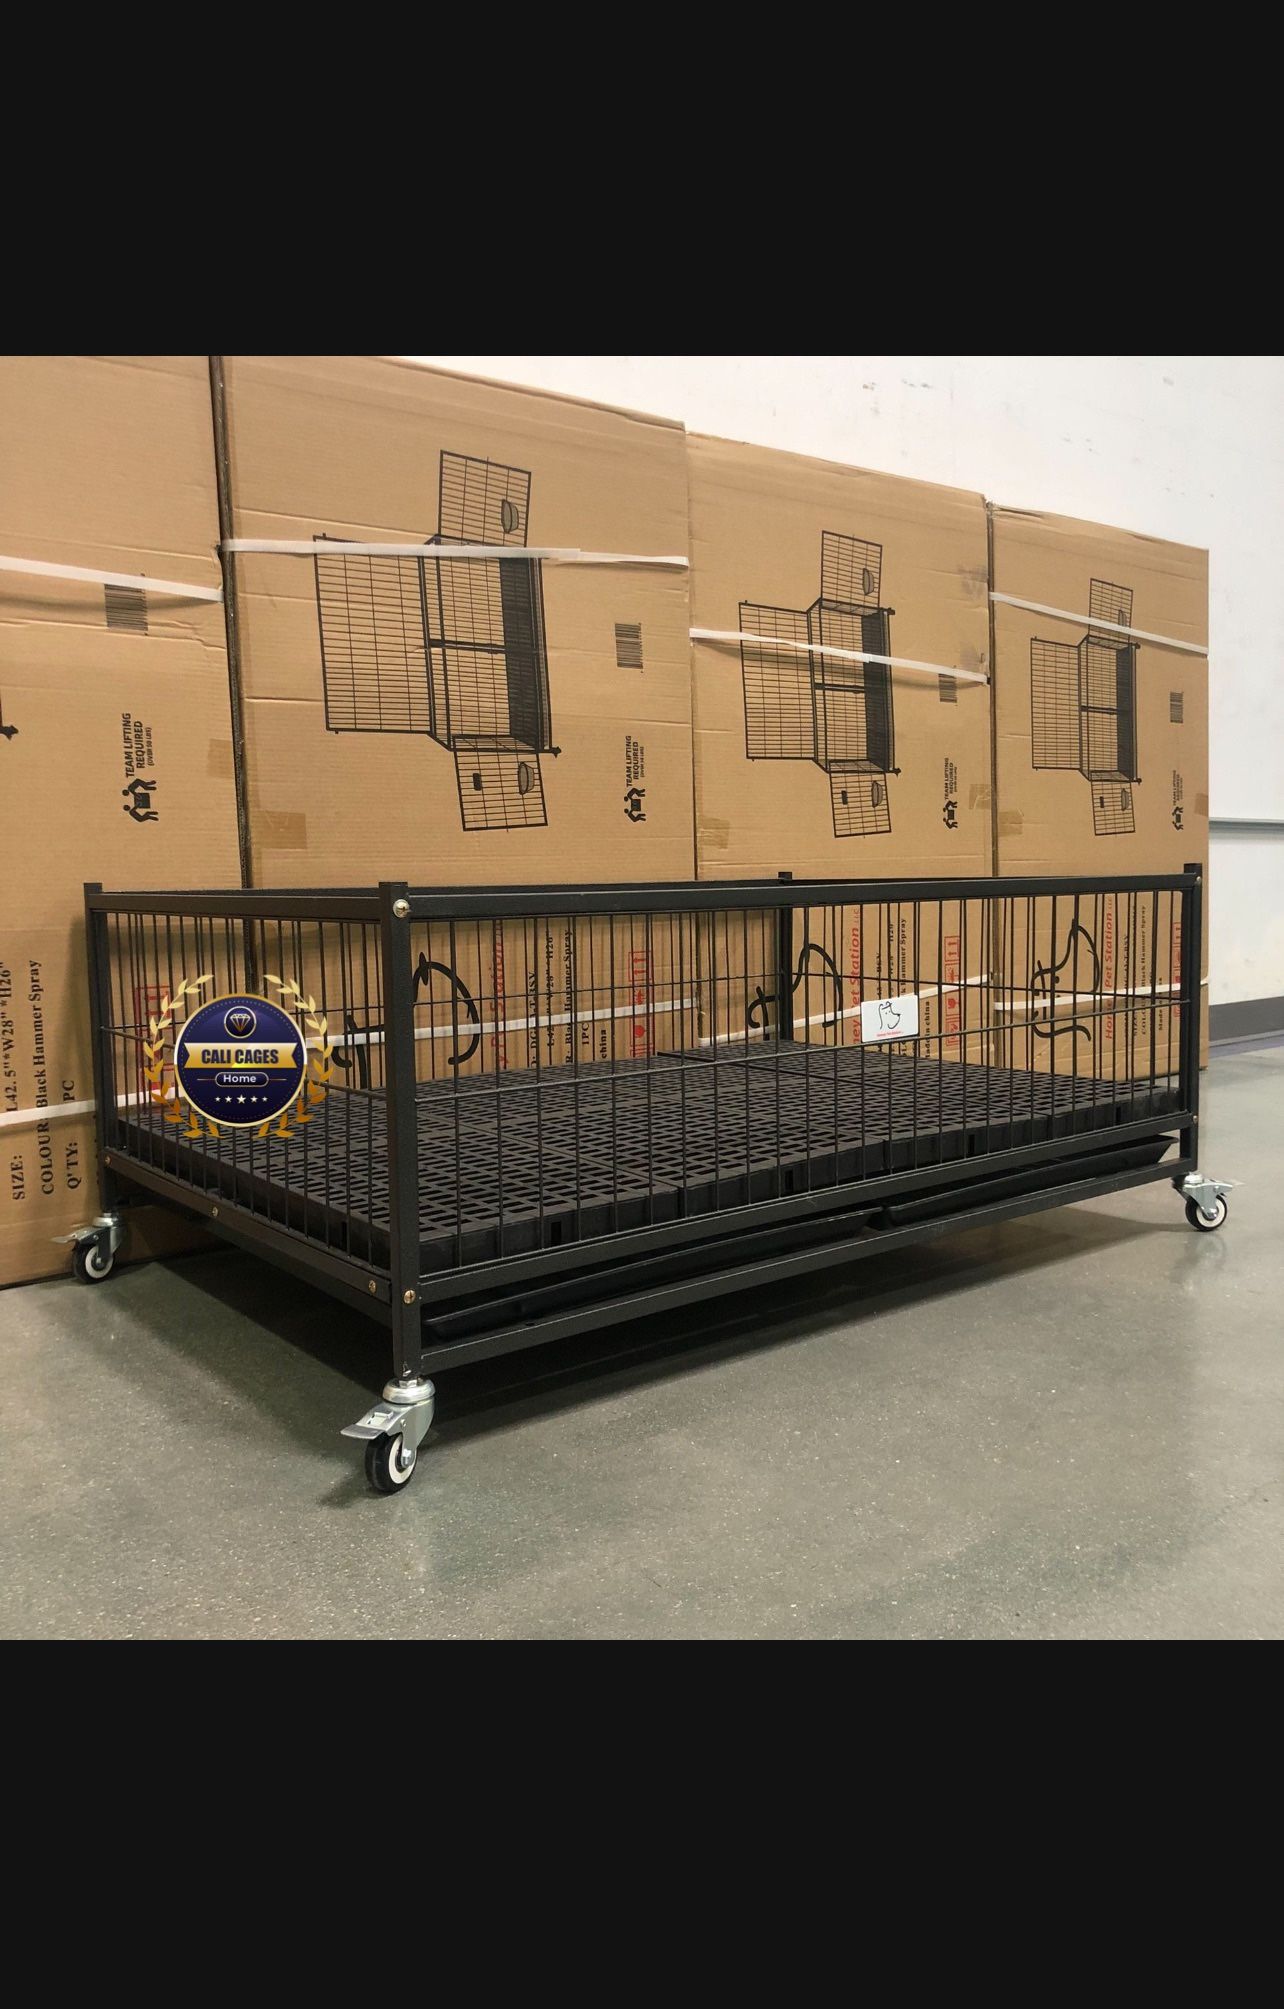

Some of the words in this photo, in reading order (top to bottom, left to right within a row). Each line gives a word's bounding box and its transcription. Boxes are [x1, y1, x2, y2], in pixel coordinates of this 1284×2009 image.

[122, 713, 133, 749] LIFTING
[133, 720, 145, 769] REQUIRED
[124, 751, 134, 778] TEAM
[632, 741, 640, 780] REQUIRED
[899, 918, 908, 945] Spray
[1105, 912, 1113, 963] Station
[848, 928, 861, 986] Station
[28, 960, 45, 1002] Spray
[31, 1005, 46, 1065] Hammer
[599, 1029, 607, 1059] china
[34, 1069, 49, 1108] Black
[10, 1155, 26, 1201] SIZE:
